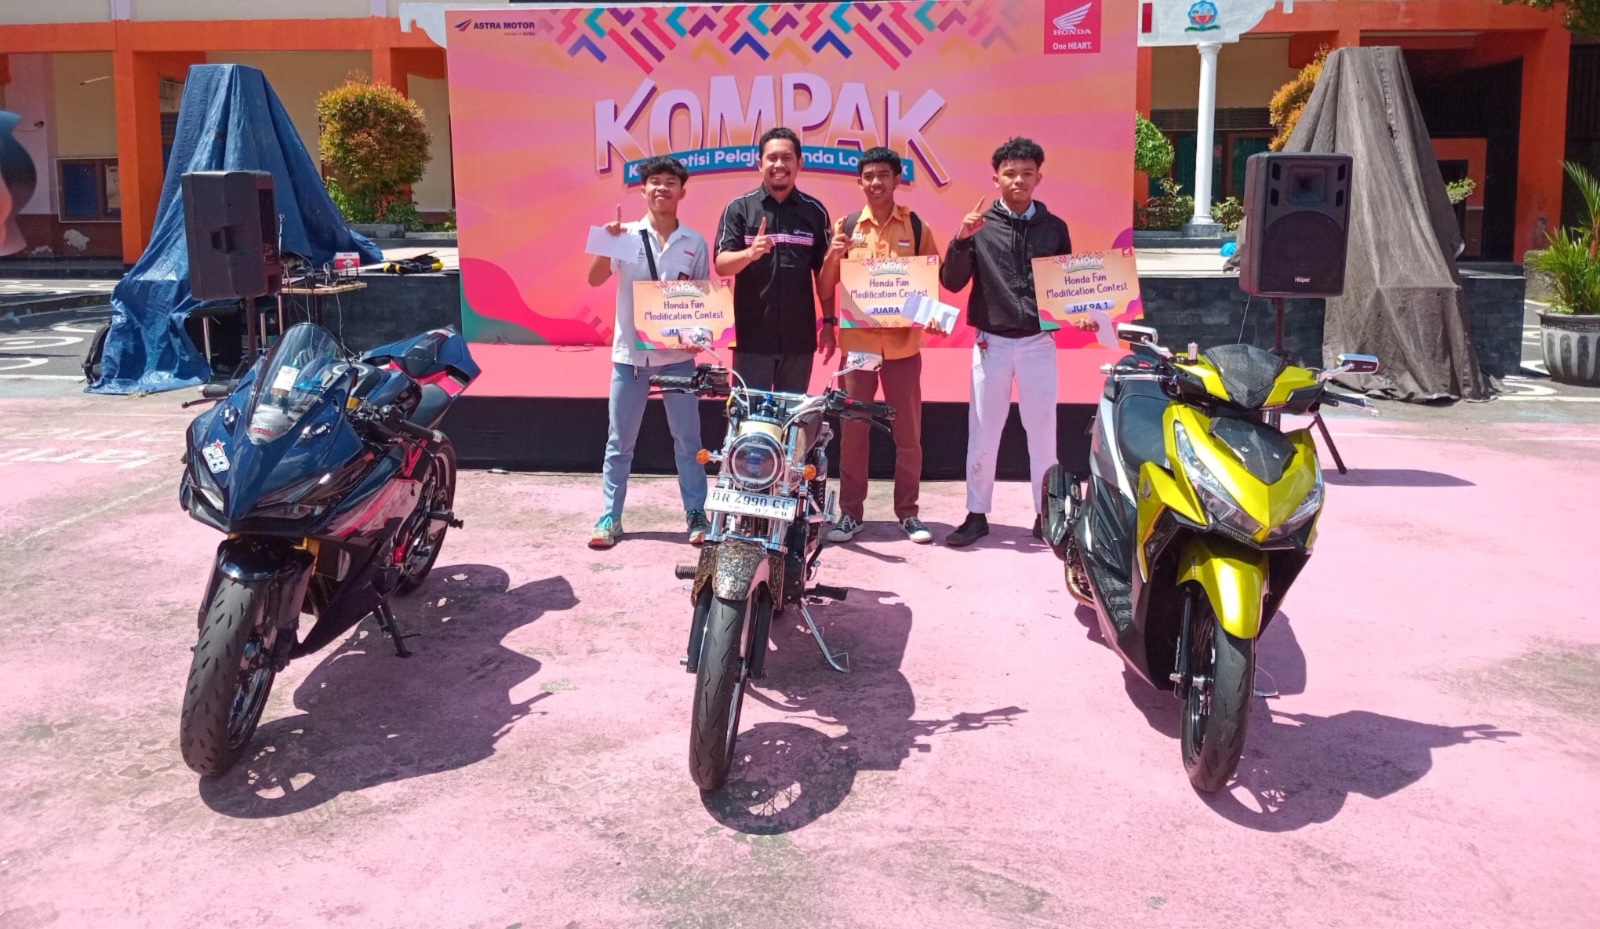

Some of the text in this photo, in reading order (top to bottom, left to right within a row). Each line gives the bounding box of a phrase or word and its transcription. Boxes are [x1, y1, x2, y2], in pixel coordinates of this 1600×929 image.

[473, 21, 535, 30] ASTRA MOTOR
[1052, 42, 1067, 50] One
[594, 72, 951, 184] KOMPAK
[869, 277, 910, 288] Honda Fun
[1064, 272, 1107, 285] Honda Fun
[850, 289, 897, 299] Modification
[1046, 282, 1129, 299] Modification Contest
[663, 299, 705, 310] Honda Fun
[1103, 301, 1109, 310] 1
[644, 310, 724, 321] Modification Contest
[871, 306, 901, 315] JUARA
